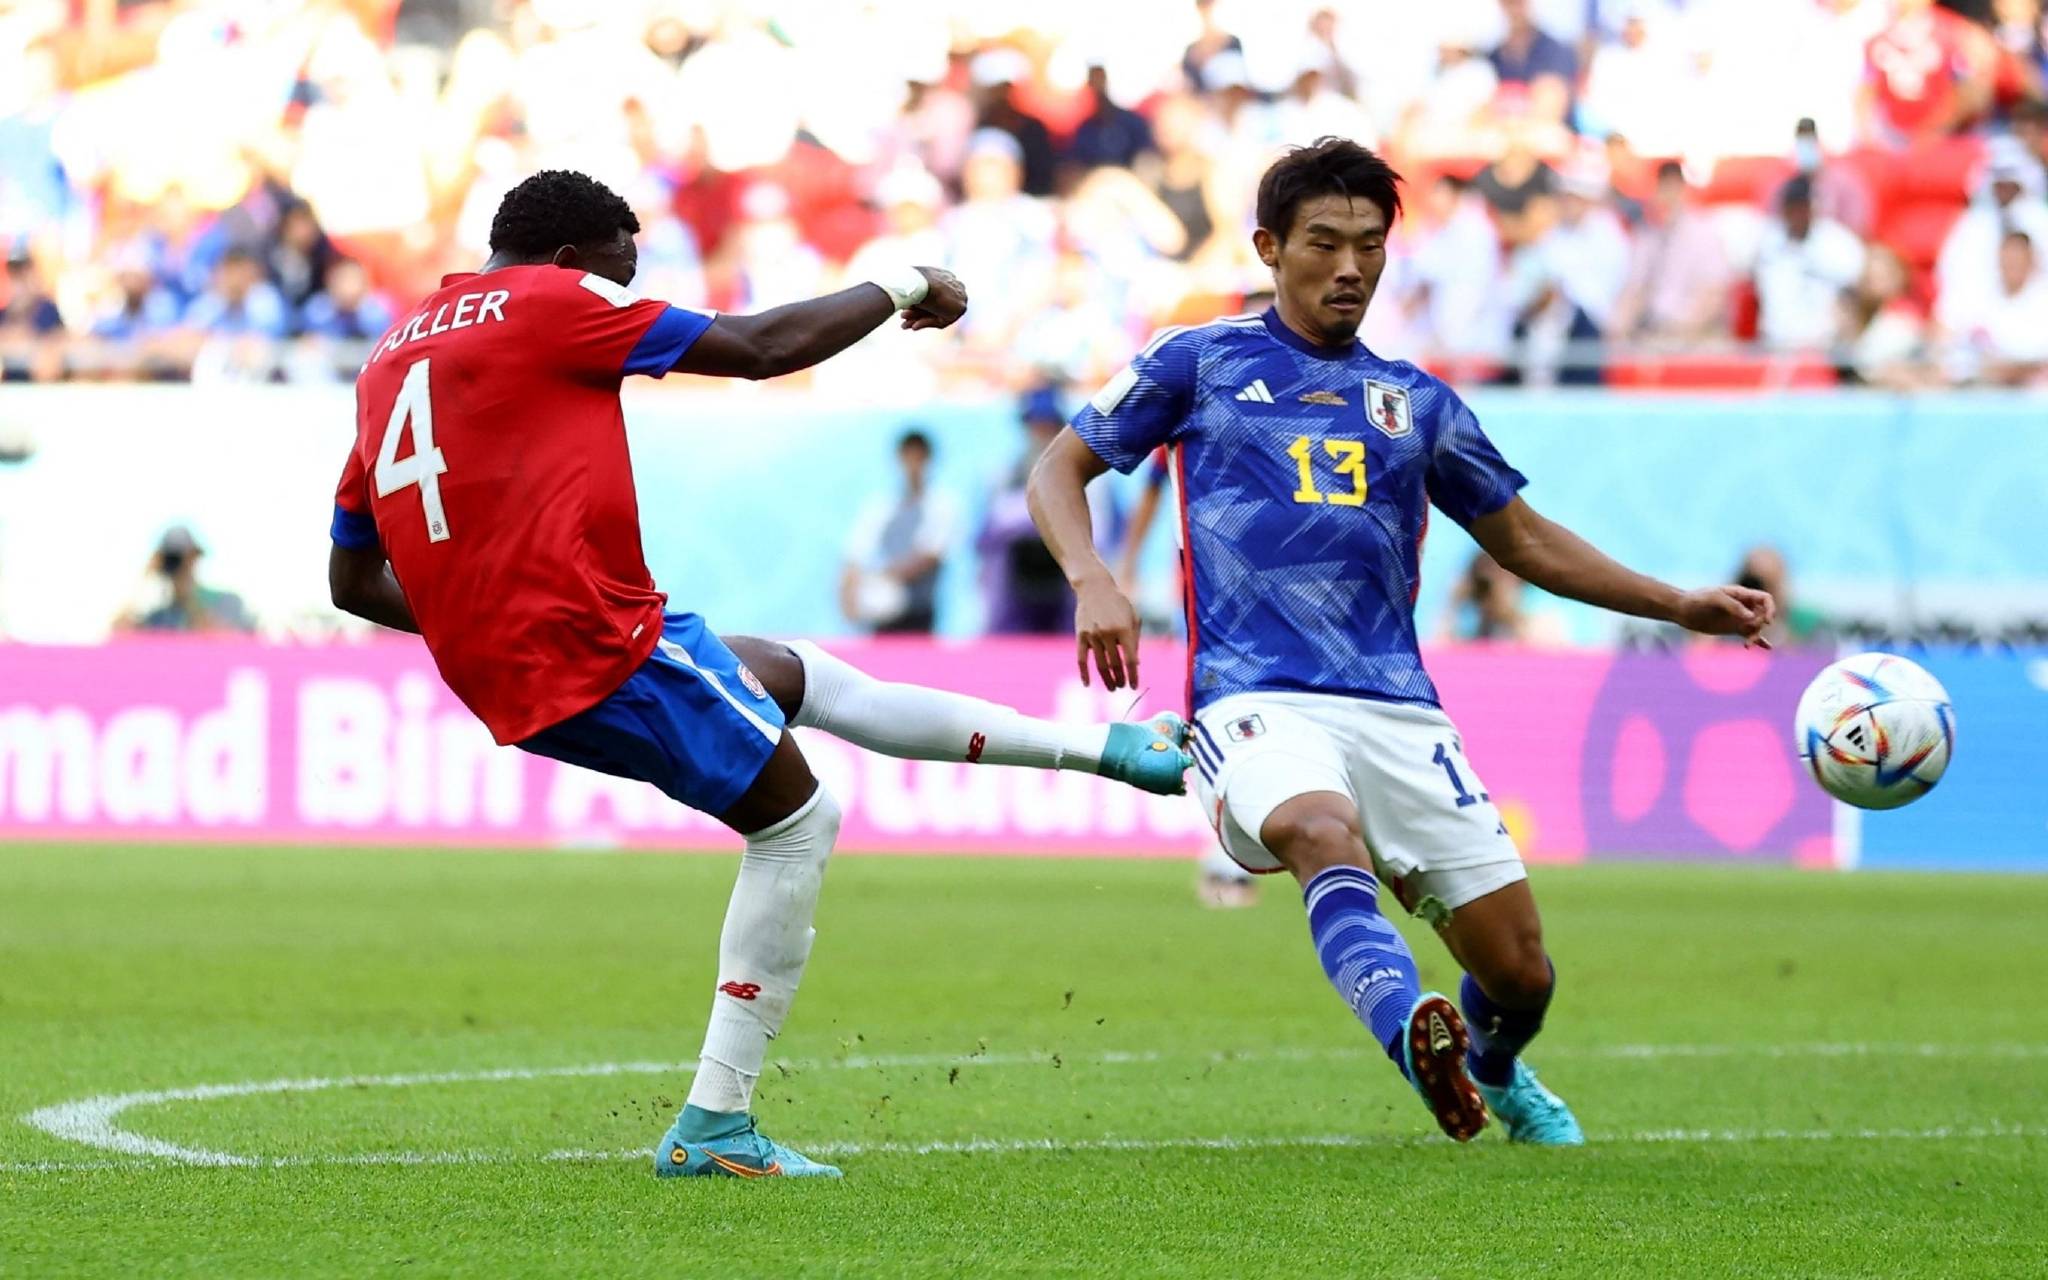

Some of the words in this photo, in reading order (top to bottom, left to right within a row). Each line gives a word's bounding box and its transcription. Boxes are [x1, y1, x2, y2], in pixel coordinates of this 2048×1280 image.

[374, 357, 449, 544] 4
[1287, 435, 1369, 507] 13
[299, 676, 525, 828] Bin
[1432, 741, 1490, 808] 1
